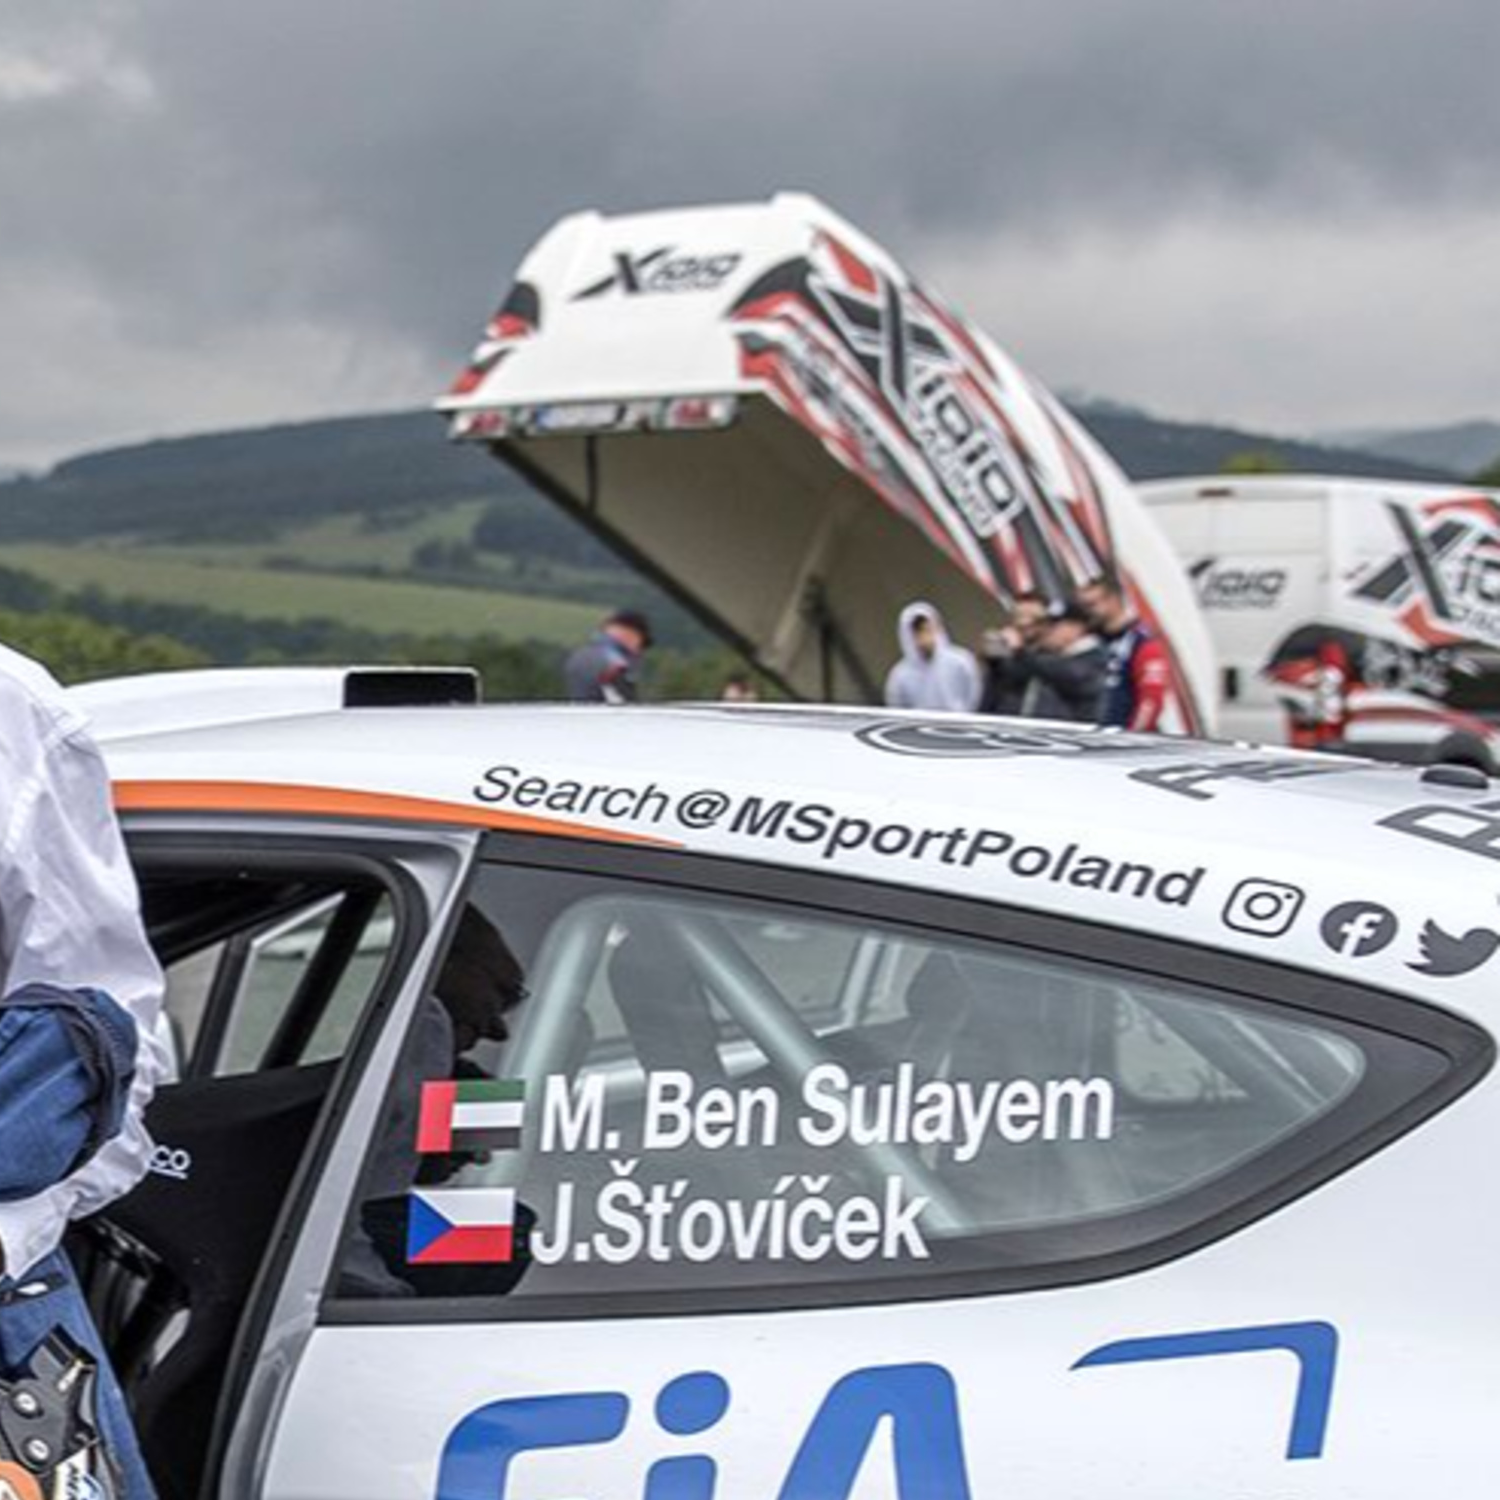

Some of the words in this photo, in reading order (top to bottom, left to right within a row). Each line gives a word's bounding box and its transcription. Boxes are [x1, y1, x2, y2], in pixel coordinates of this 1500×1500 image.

[540, 1074, 621, 1152] M.
[643, 1069, 779, 1150] Ben
[799, 1062, 1113, 1162] Sulayem
[530, 1158, 930, 1263] J.Šťovíček
